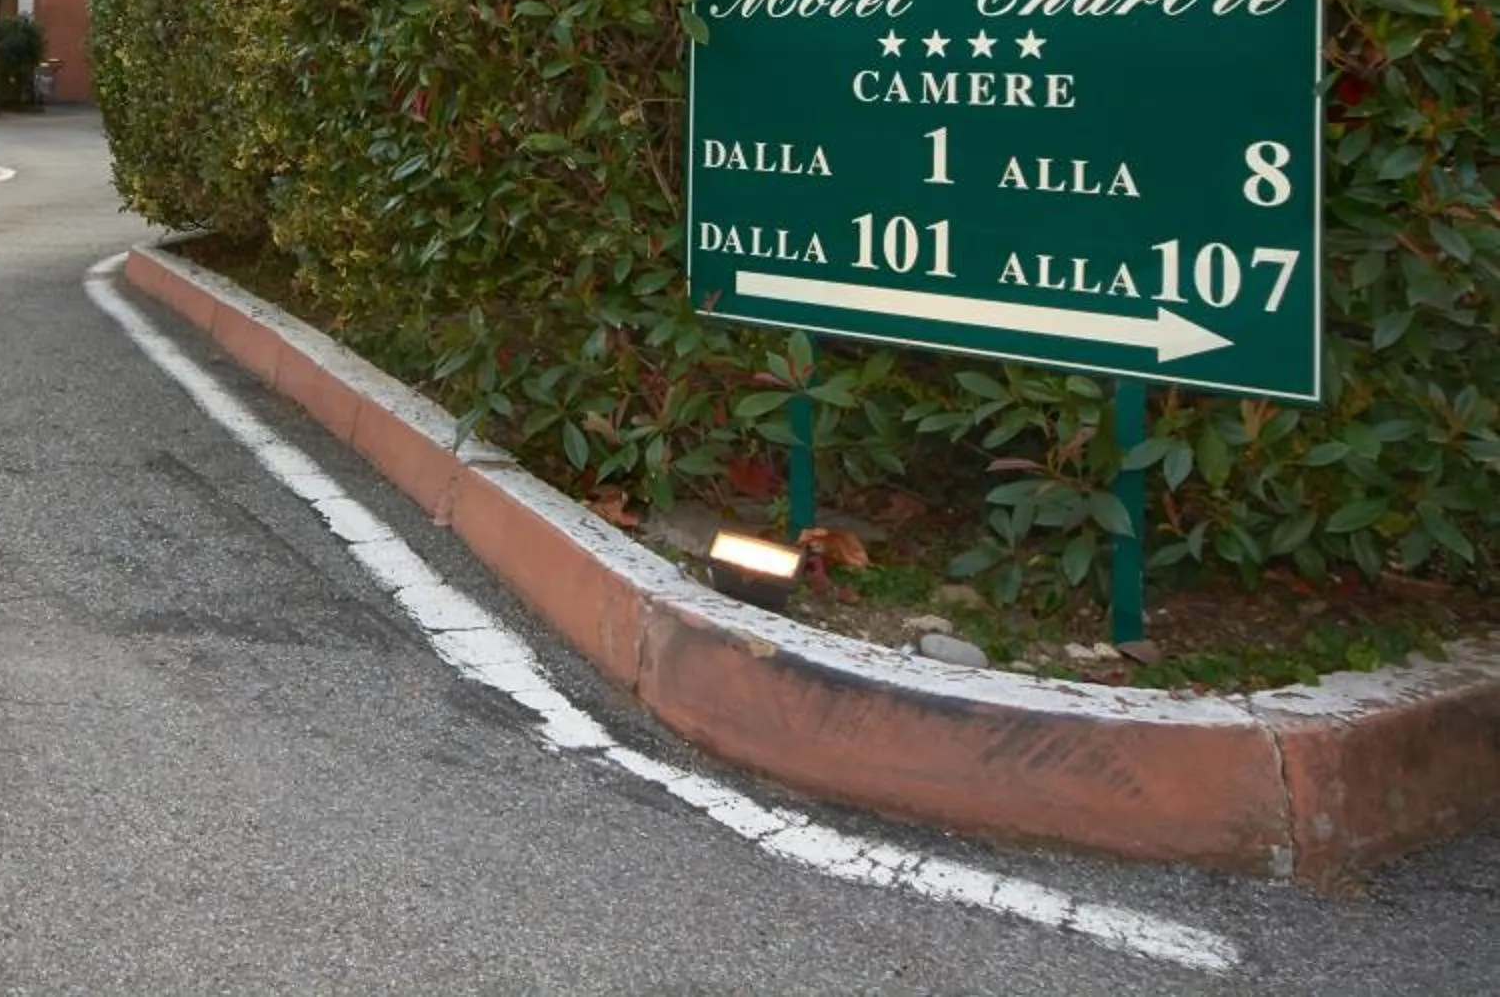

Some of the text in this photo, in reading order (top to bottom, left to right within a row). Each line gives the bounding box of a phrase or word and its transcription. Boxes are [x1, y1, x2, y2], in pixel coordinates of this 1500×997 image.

[853, 71, 1075, 107] CAMERE
[704, 127, 1291, 206] DALLA 1 ALLA 8
[700, 214, 1299, 312] DALLA 101 ALLA 107
